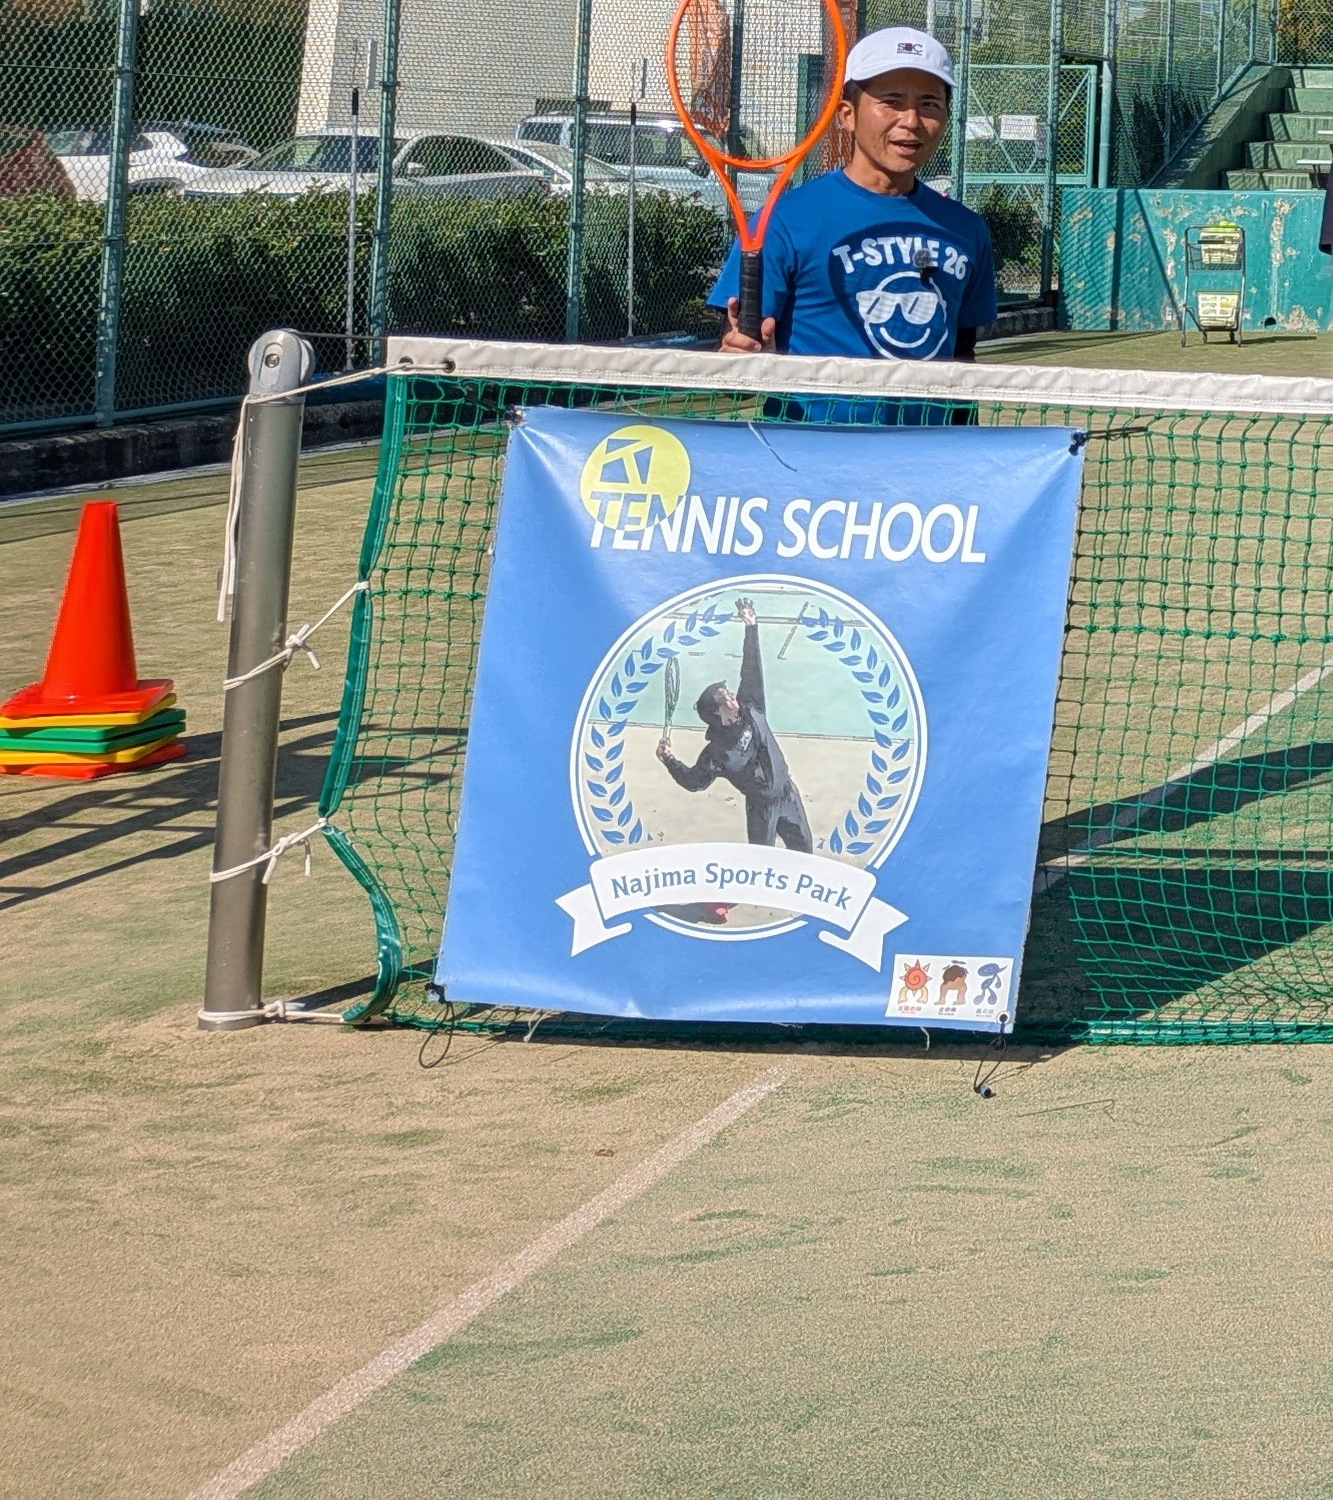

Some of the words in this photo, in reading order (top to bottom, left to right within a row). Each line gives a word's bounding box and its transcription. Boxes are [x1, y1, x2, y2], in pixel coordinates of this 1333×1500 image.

[943, 246, 969, 280] 26
[589, 490, 768, 556] TENNIS
[776, 498, 986, 563] SCHOOL
[610, 867, 697, 899] Najima
[705, 862, 788, 890] Sports
[794, 873, 852, 911] Park
